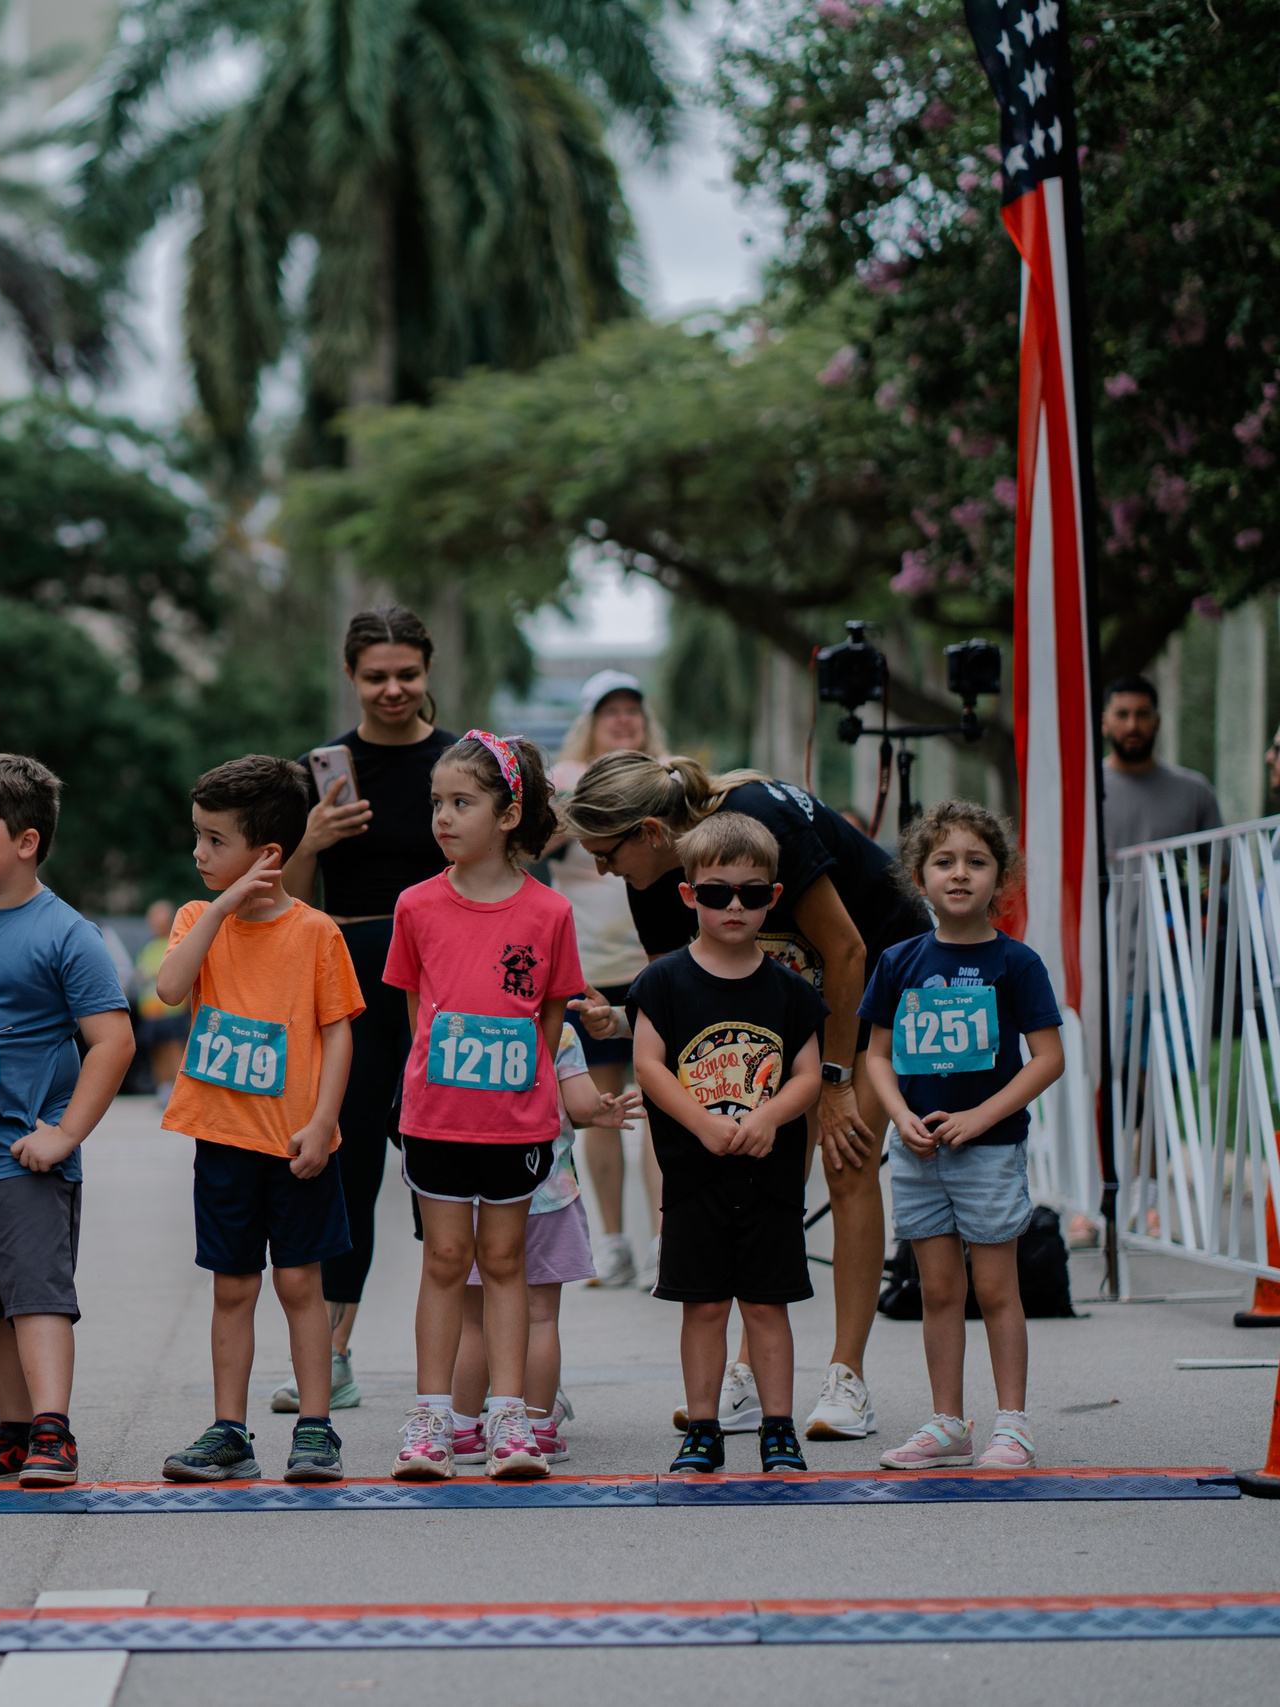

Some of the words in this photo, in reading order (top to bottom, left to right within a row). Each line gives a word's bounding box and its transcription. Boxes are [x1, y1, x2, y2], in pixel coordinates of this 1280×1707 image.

[958, 966, 980, 977] DINO
[950, 977, 984, 987] HUNTER
[232, 1025, 251, 1037] Taco
[252, 1030, 269, 1040] Trot
[480, 1026, 501, 1035] Taco
[502, 1027, 518, 1036] Trot
[900, 1008, 989, 1055] 1251
[196, 1032, 277, 1089] 1219
[438, 1036, 528, 1086] 1218
[689, 1052, 740, 1080] Cinco
[932, 1062, 955, 1070] TACO
[714, 1070, 724, 1080] de
